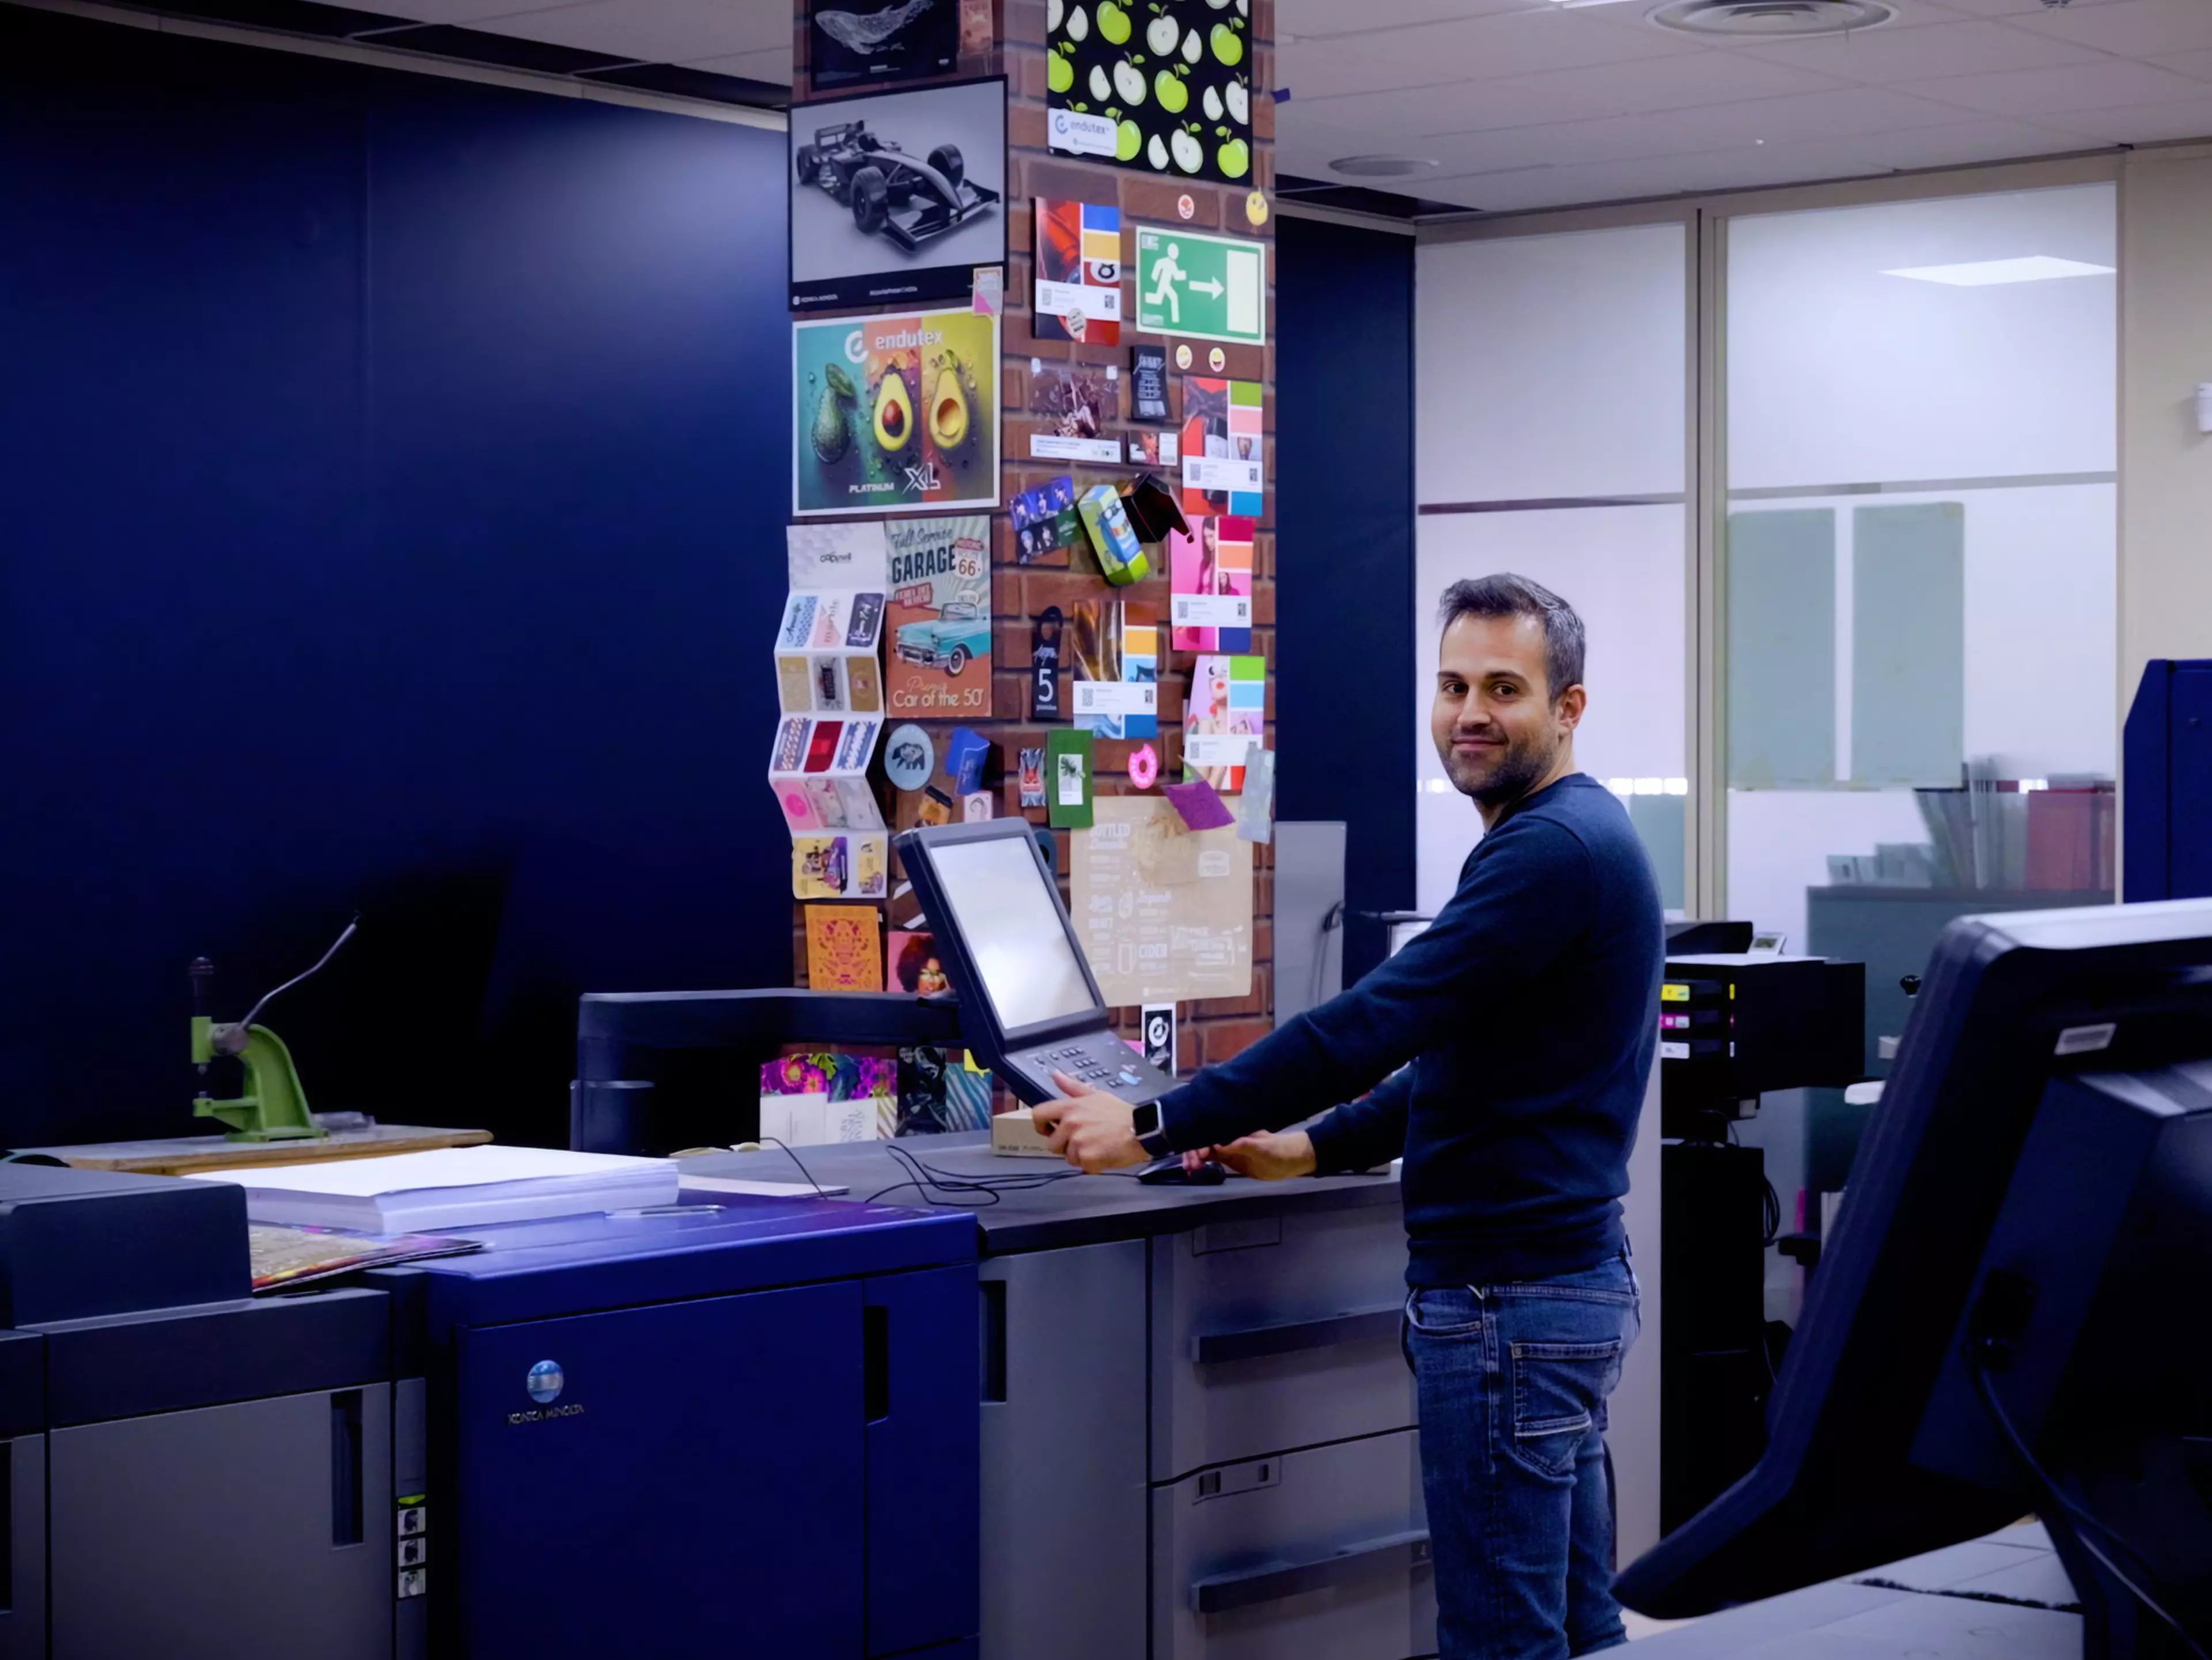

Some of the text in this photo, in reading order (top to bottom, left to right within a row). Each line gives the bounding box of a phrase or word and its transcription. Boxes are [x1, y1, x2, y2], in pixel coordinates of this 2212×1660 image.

[875, 328, 943, 349] endutex
[849, 483, 894, 493] PLATINUM
[901, 462, 941, 496] XL
[892, 544, 956, 584] GARAGE
[1039, 668, 1054, 702] 5
[893, 690, 918, 708] Car
[922, 690, 937, 707] of
[938, 690, 959, 707] the
